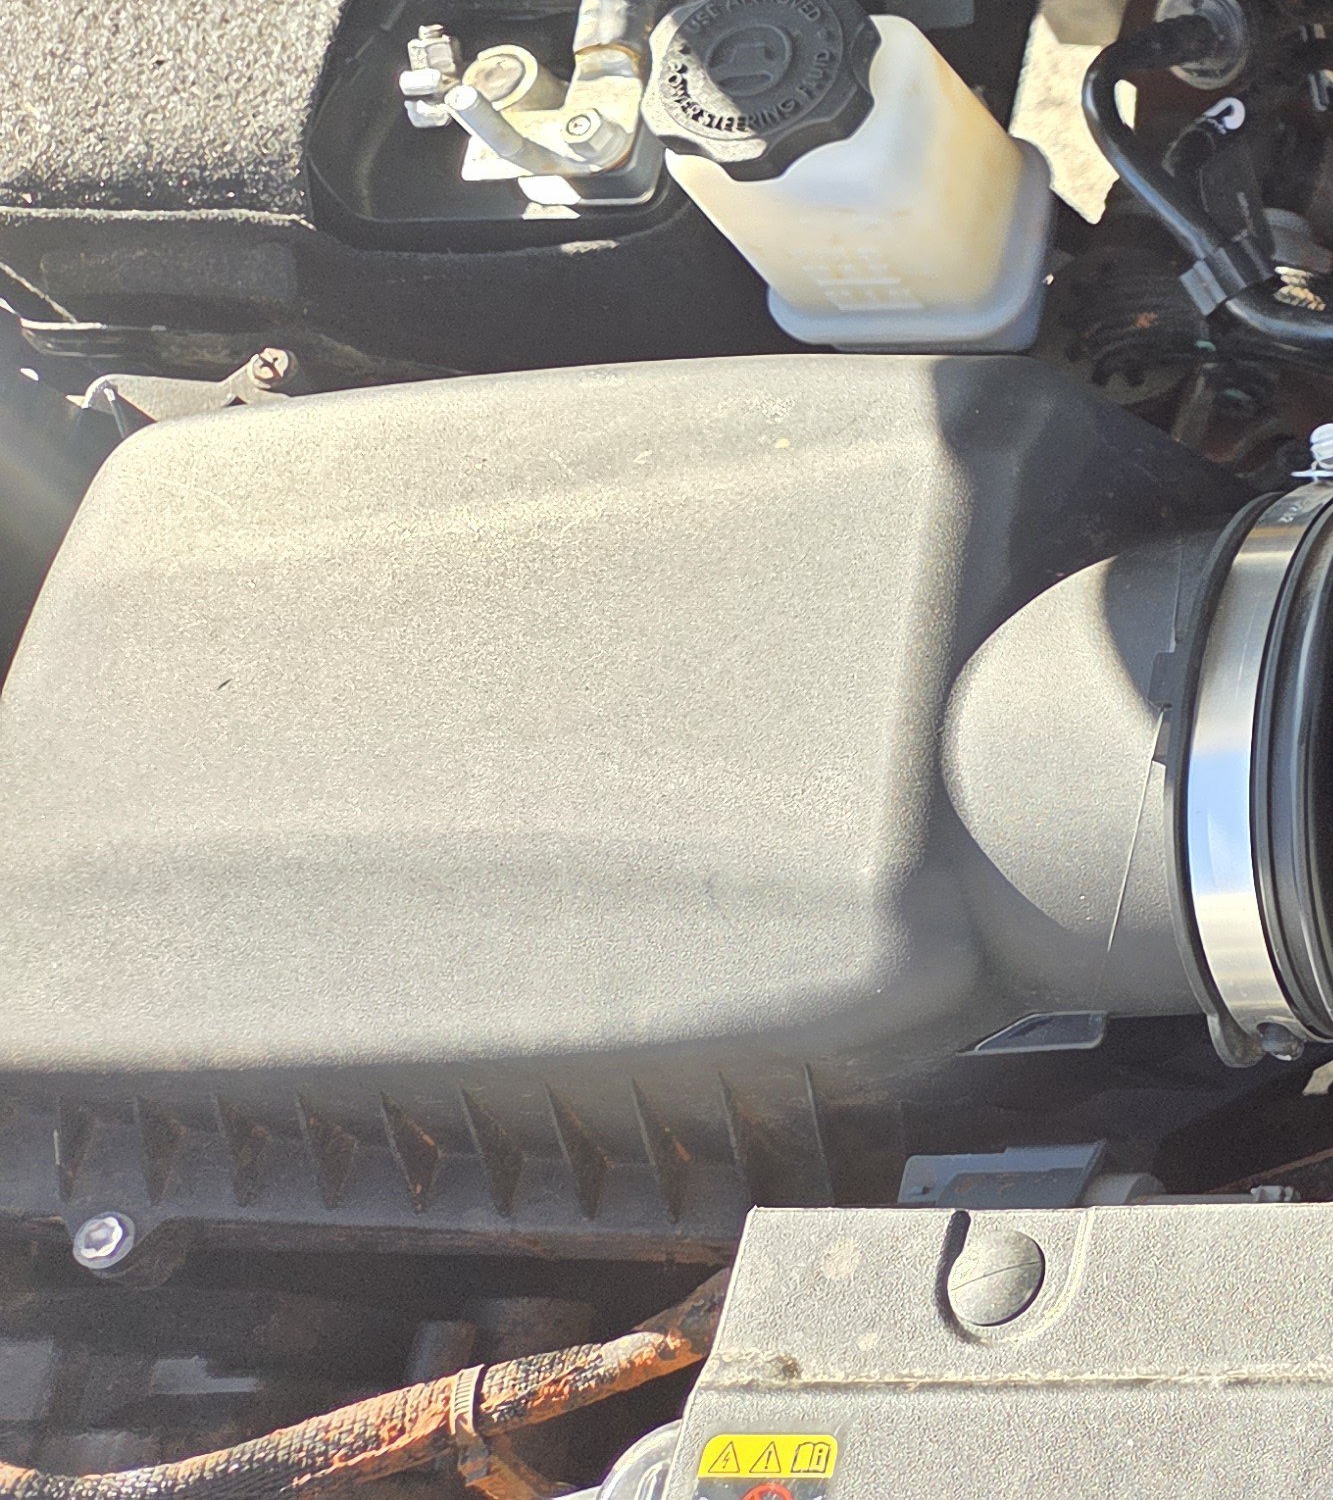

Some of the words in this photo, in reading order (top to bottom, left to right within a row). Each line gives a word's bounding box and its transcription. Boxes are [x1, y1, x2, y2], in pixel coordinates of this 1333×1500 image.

[687, 4, 721, 35] USE
[667, 59, 706, 122] POWER
[702, 97, 797, 133] STEERING
